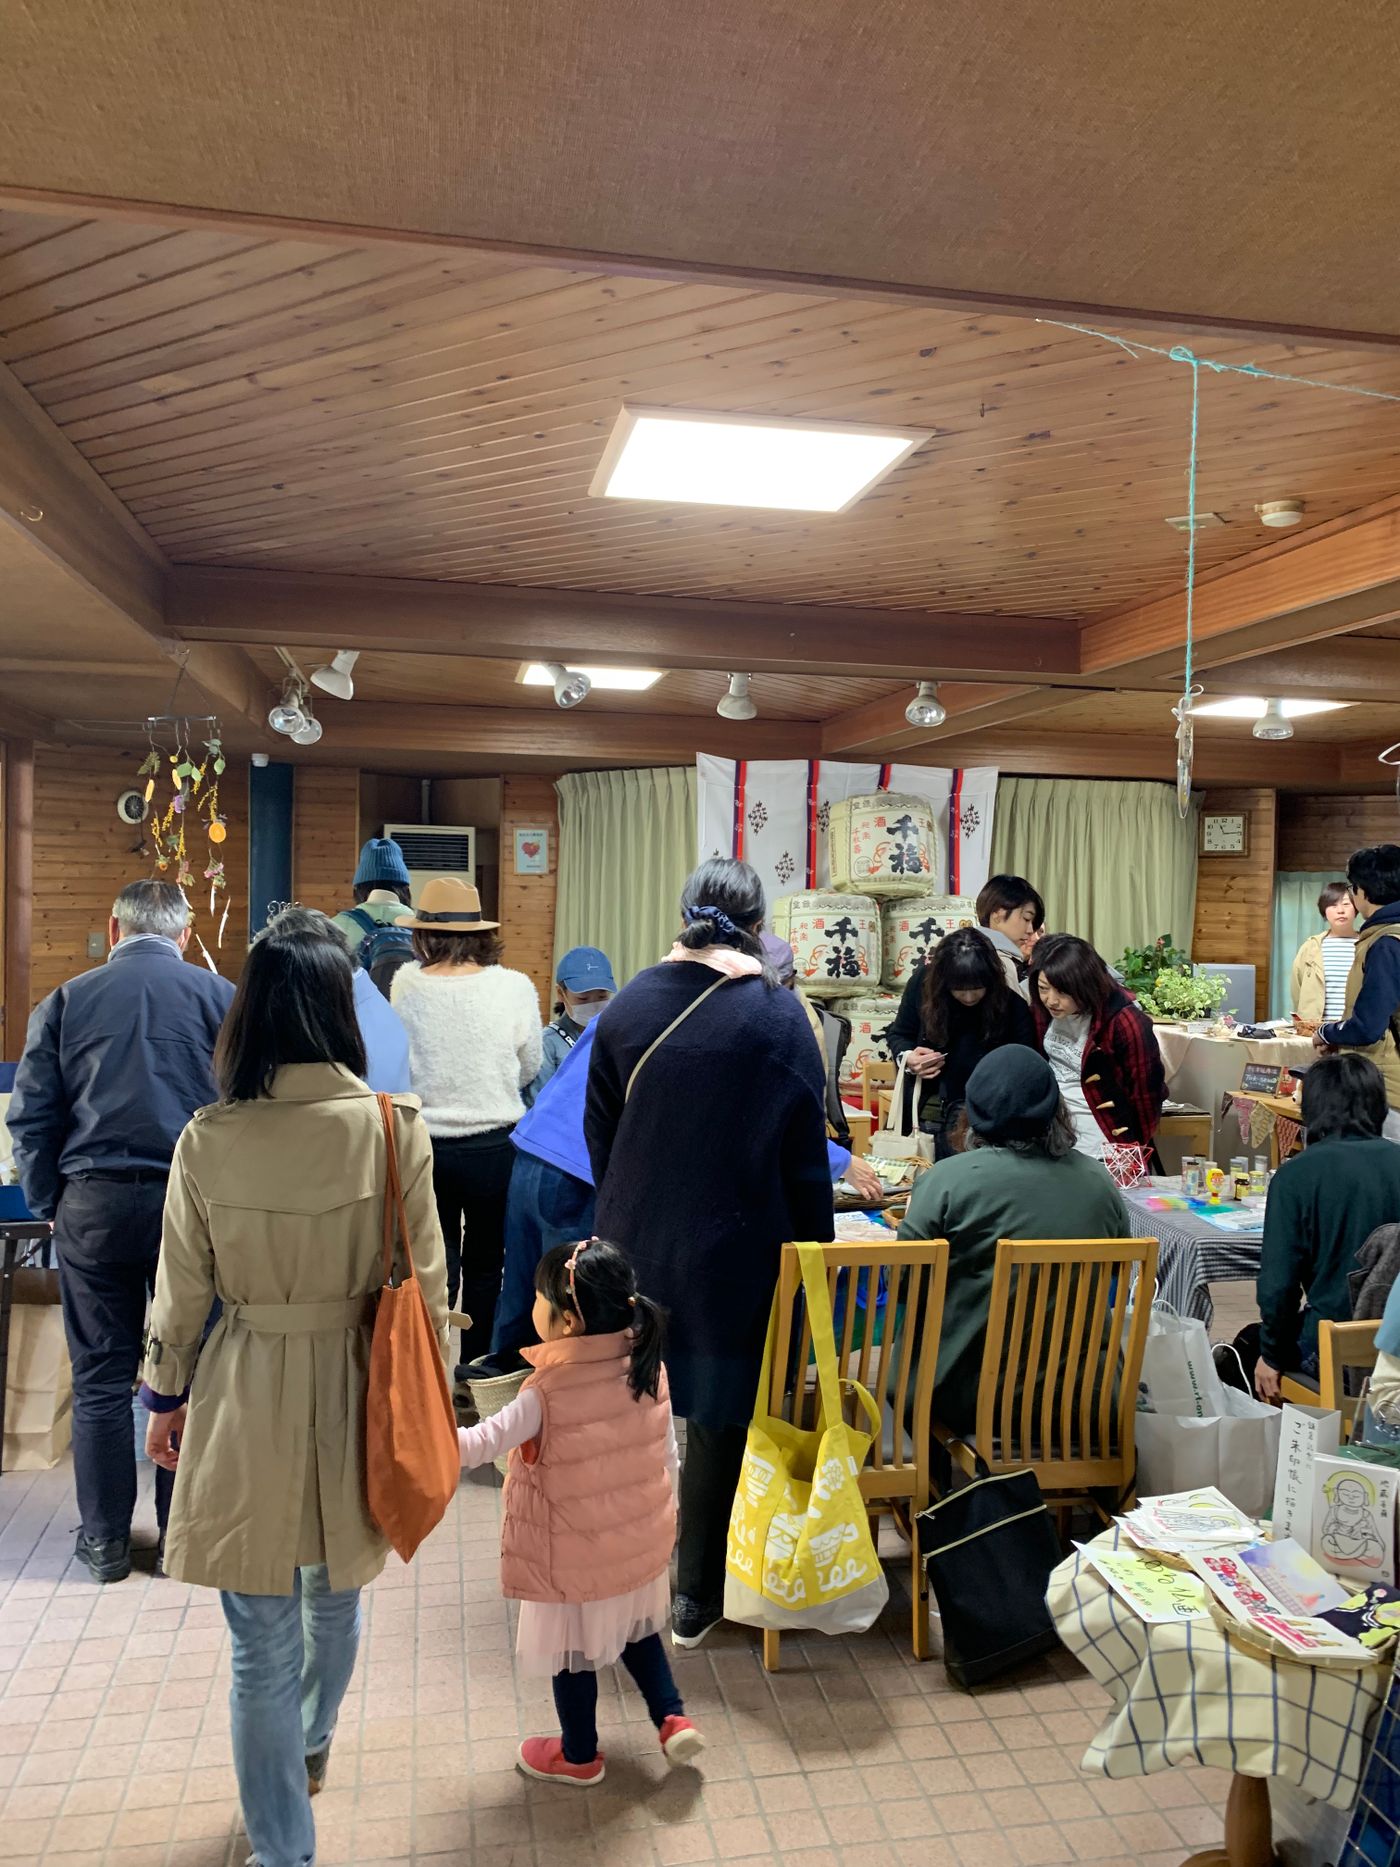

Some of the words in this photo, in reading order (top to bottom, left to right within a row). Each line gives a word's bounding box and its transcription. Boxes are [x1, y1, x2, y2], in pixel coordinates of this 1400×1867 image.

[874, 816, 887, 828] 酒
[886, 814, 922, 875] 千福
[812, 917, 825, 929] 酒
[824, 916, 860, 979] 千福
[859, 1022, 871, 1034] 酒
